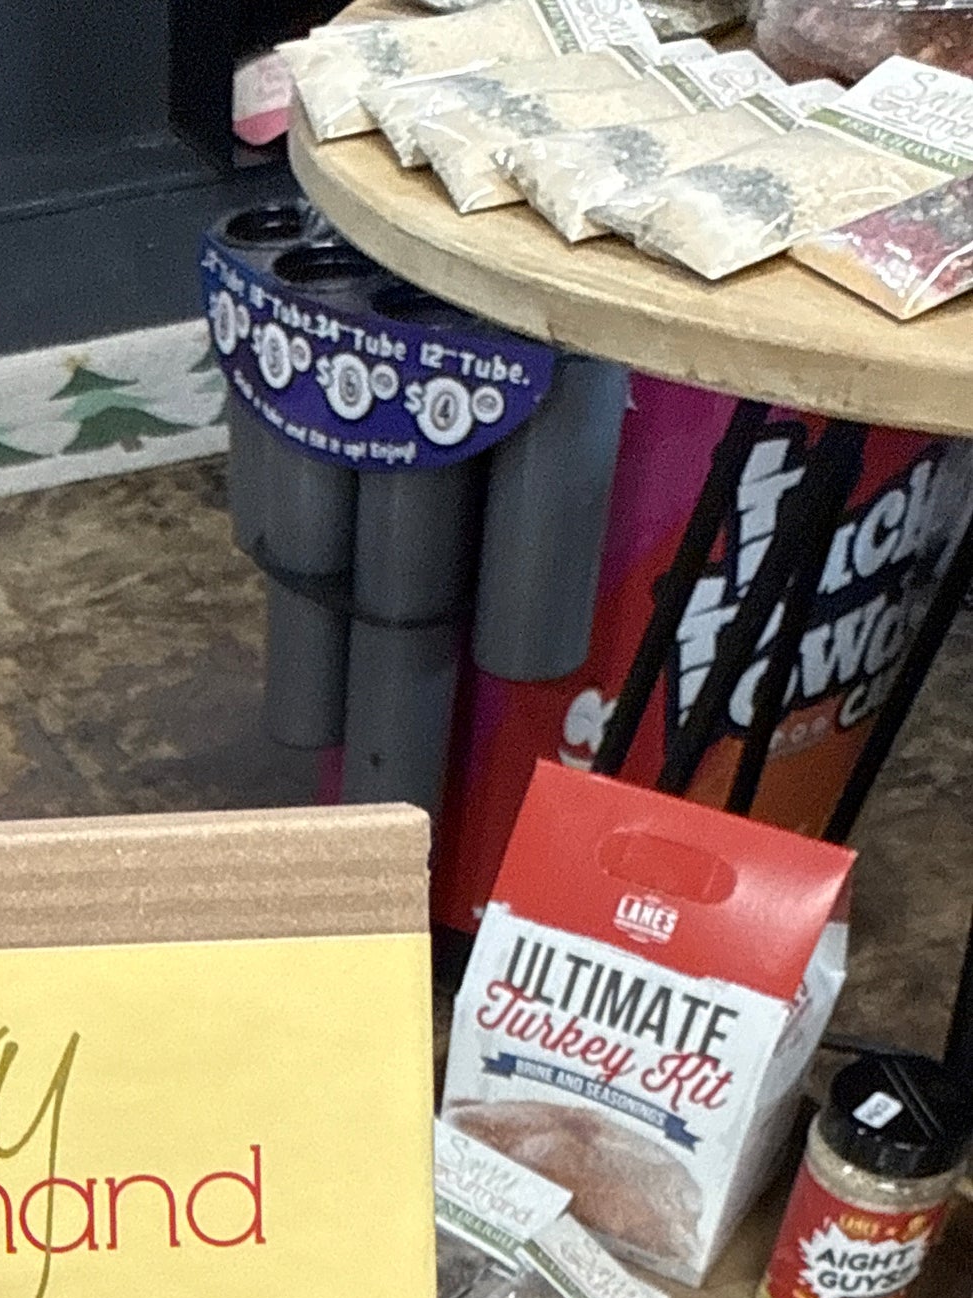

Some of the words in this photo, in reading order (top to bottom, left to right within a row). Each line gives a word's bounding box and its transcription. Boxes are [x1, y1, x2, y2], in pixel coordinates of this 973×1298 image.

[476, 980, 637, 1085] Turkey
[640, 1052, 735, 1112] Kit
[505, 936, 740, 1065] ULTIMATE
[814, 1245, 915, 1273] AIGHT
